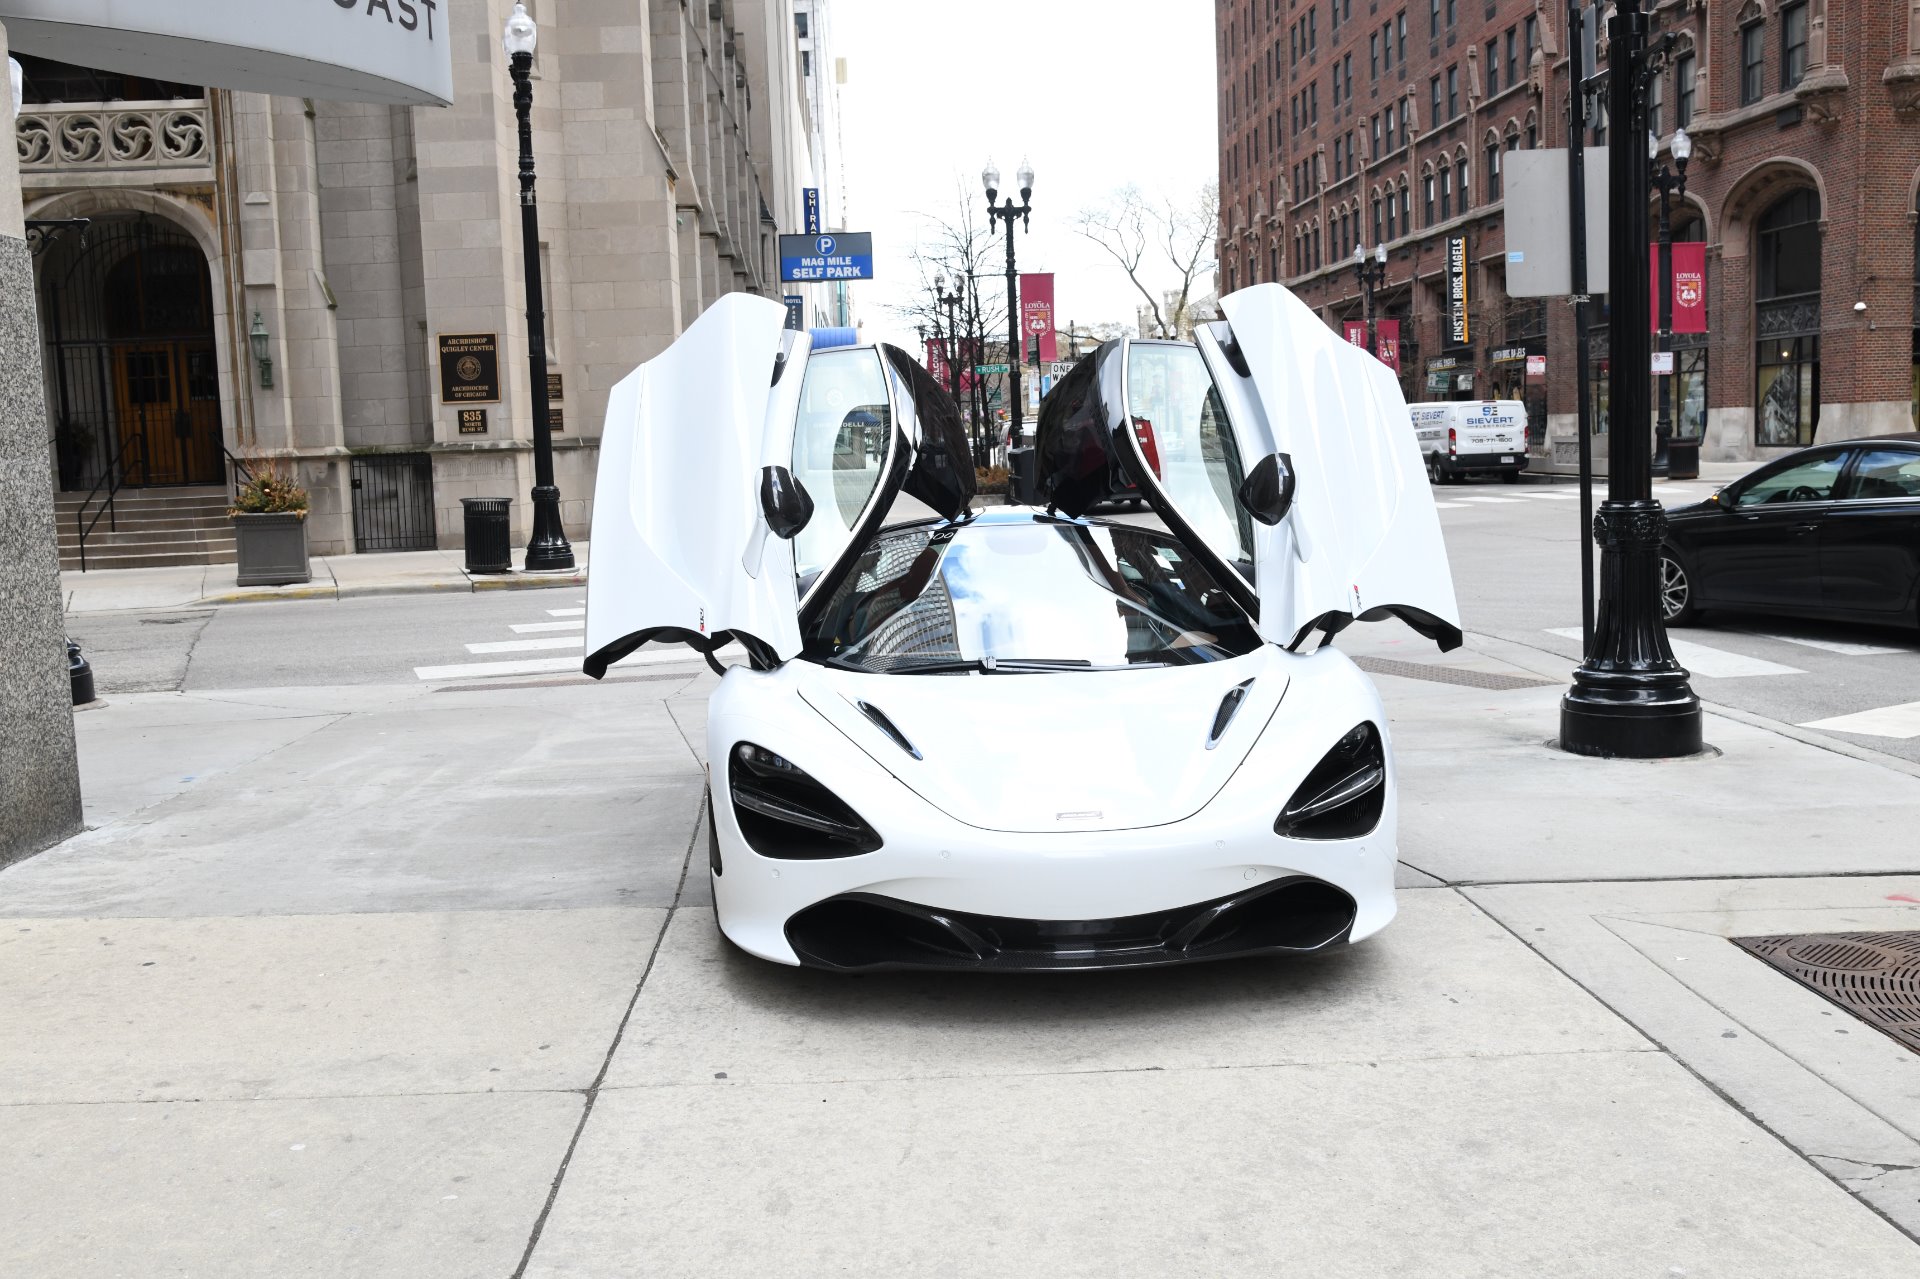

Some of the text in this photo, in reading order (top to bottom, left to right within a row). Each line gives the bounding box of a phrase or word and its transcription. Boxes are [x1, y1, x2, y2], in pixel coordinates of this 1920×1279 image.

[333, 0, 436, 40] AST
[808, 190, 817, 234] GHIRA
[820, 238, 832, 252] P
[801, 256, 852, 267] MAG MILE
[1452, 239, 1462, 273] BAGELS
[792, 266, 861, 279] SELF PARK
[1025, 301, 1050, 309] LOYOLA
[1453, 302, 1464, 341] EINSTEIN
[1053, 365, 1071, 373] ONE
[463, 411, 482, 421] 835
[1422, 411, 1445, 420] SIEVERT
[1466, 417, 1514, 425] SIEVERT
